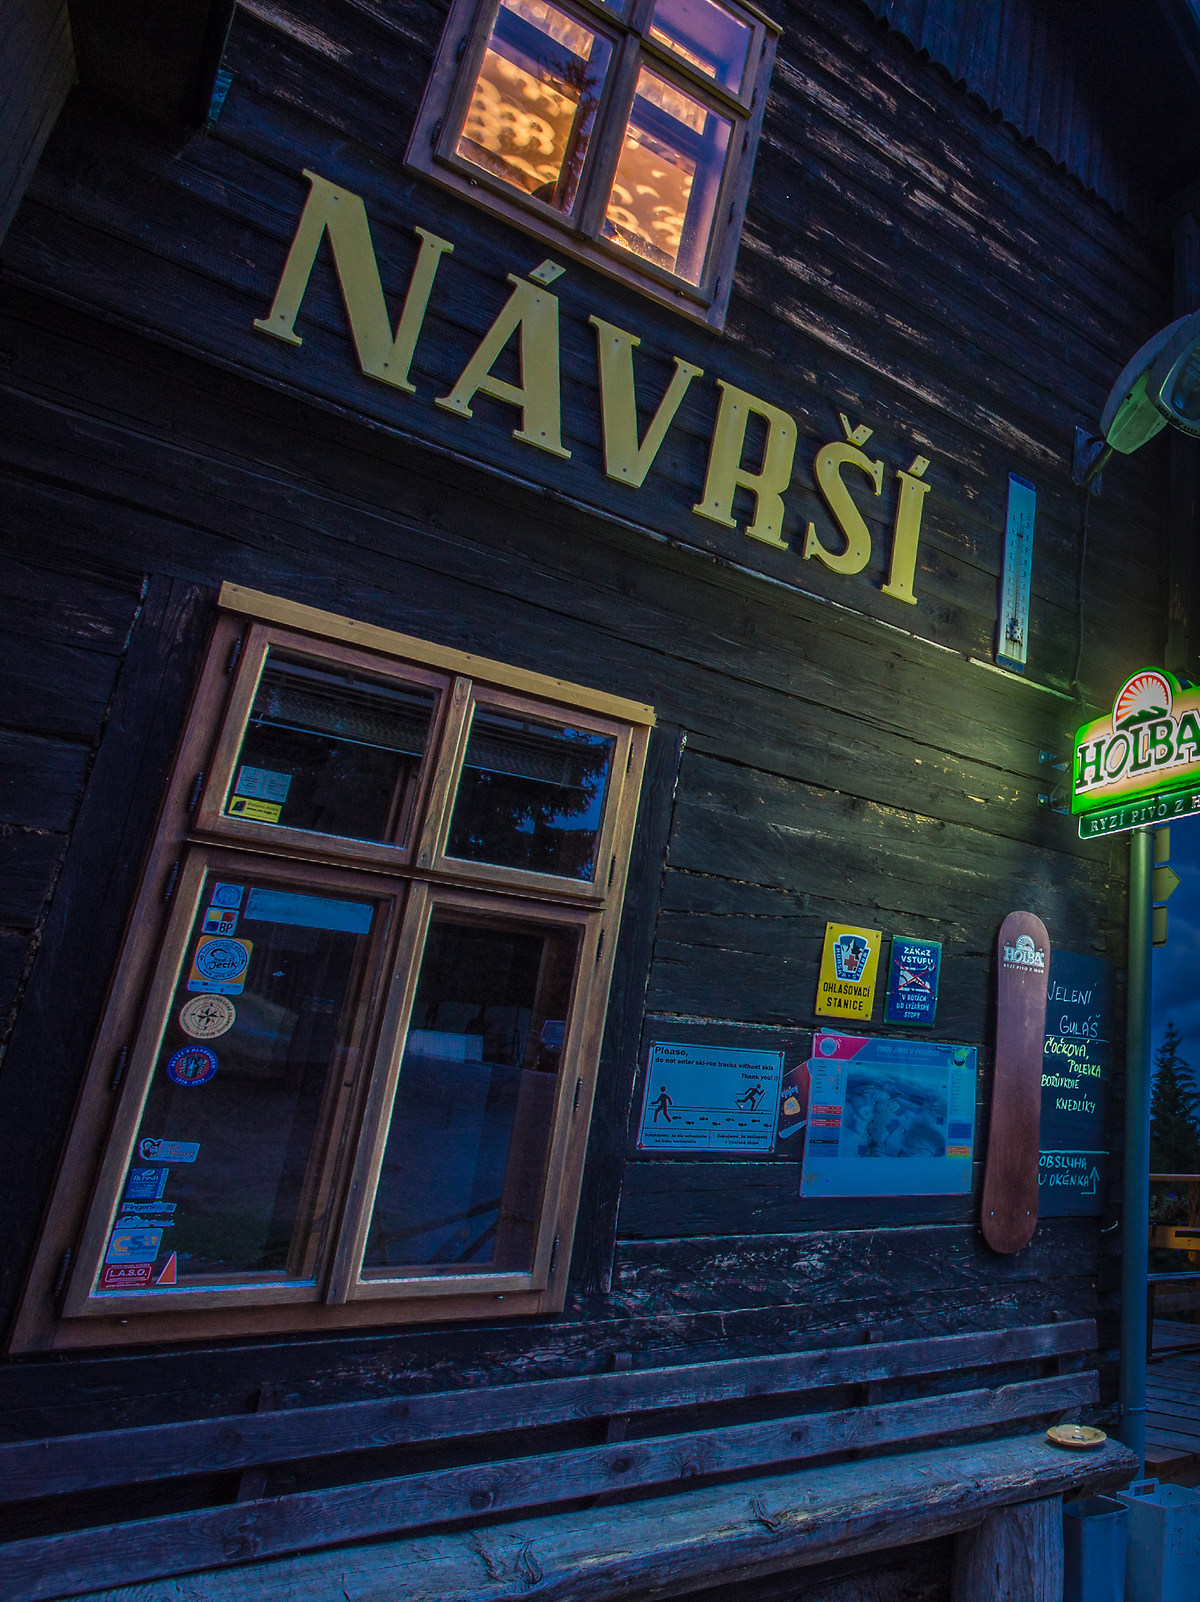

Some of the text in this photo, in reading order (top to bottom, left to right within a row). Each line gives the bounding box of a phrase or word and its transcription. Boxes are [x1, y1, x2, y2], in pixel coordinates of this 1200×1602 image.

[253, 168, 931, 604] NÁVRŠÍ
[1090, 810, 1124, 832] RYZÍ
[1131, 803, 1167, 823] PIVO
[1174, 799, 1184, 813] Z
[1003, 945, 1045, 968] HOLBA
[823, 982, 871, 998] OHLAŠOVACÍ
[1047, 981, 1097, 1005] JELENÍ
[826, 997, 864, 1011] STANICE
[1059, 1014, 1101, 1038] GULÁŠ
[655, 1047, 689, 1057] Please,
[760, 1074, 773, 1082] you!
[1055, 1093, 1096, 1113] KNEDLÍKY
[1039, 1155, 1087, 1170] OBSLUHA
[1038, 1169, 1089, 1187] U OKÉNKA
[109, 1268, 147, 1277] L.A.S.O.
